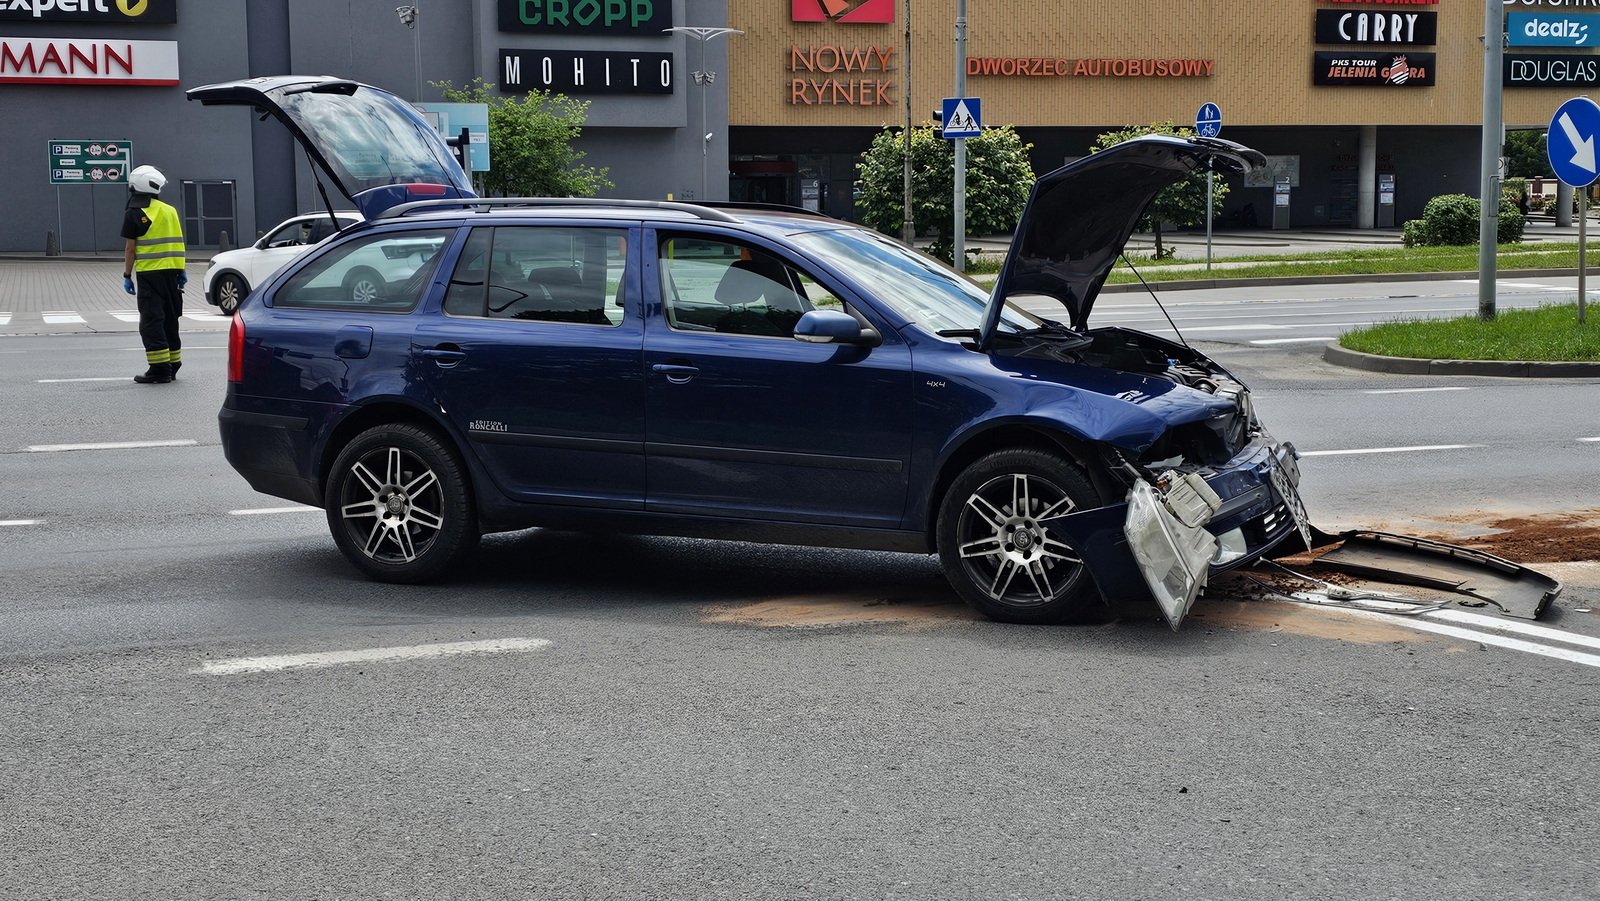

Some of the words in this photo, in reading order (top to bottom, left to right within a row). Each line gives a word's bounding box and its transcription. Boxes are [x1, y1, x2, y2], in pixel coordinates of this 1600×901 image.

[0, 0, 109, 17] xpe
[519, 0, 654, 27] CROPP
[1338, 12, 1418, 42] CARRY
[1524, 18, 1581, 39] dealz
[0, 42, 133, 75] MANN
[791, 45, 894, 73] NOWY
[966, 57, 1069, 76] DWORZEC
[1073, 59, 1216, 78] AUTOBUSOWY
[1510, 60, 1597, 81] DOUGLAS
[505, 56, 671, 87] MOHITO
[1327, 66, 1377, 78] JELENIA
[791, 79, 894, 106] RYNEK
[469, 421, 508, 431] RONCALLI
